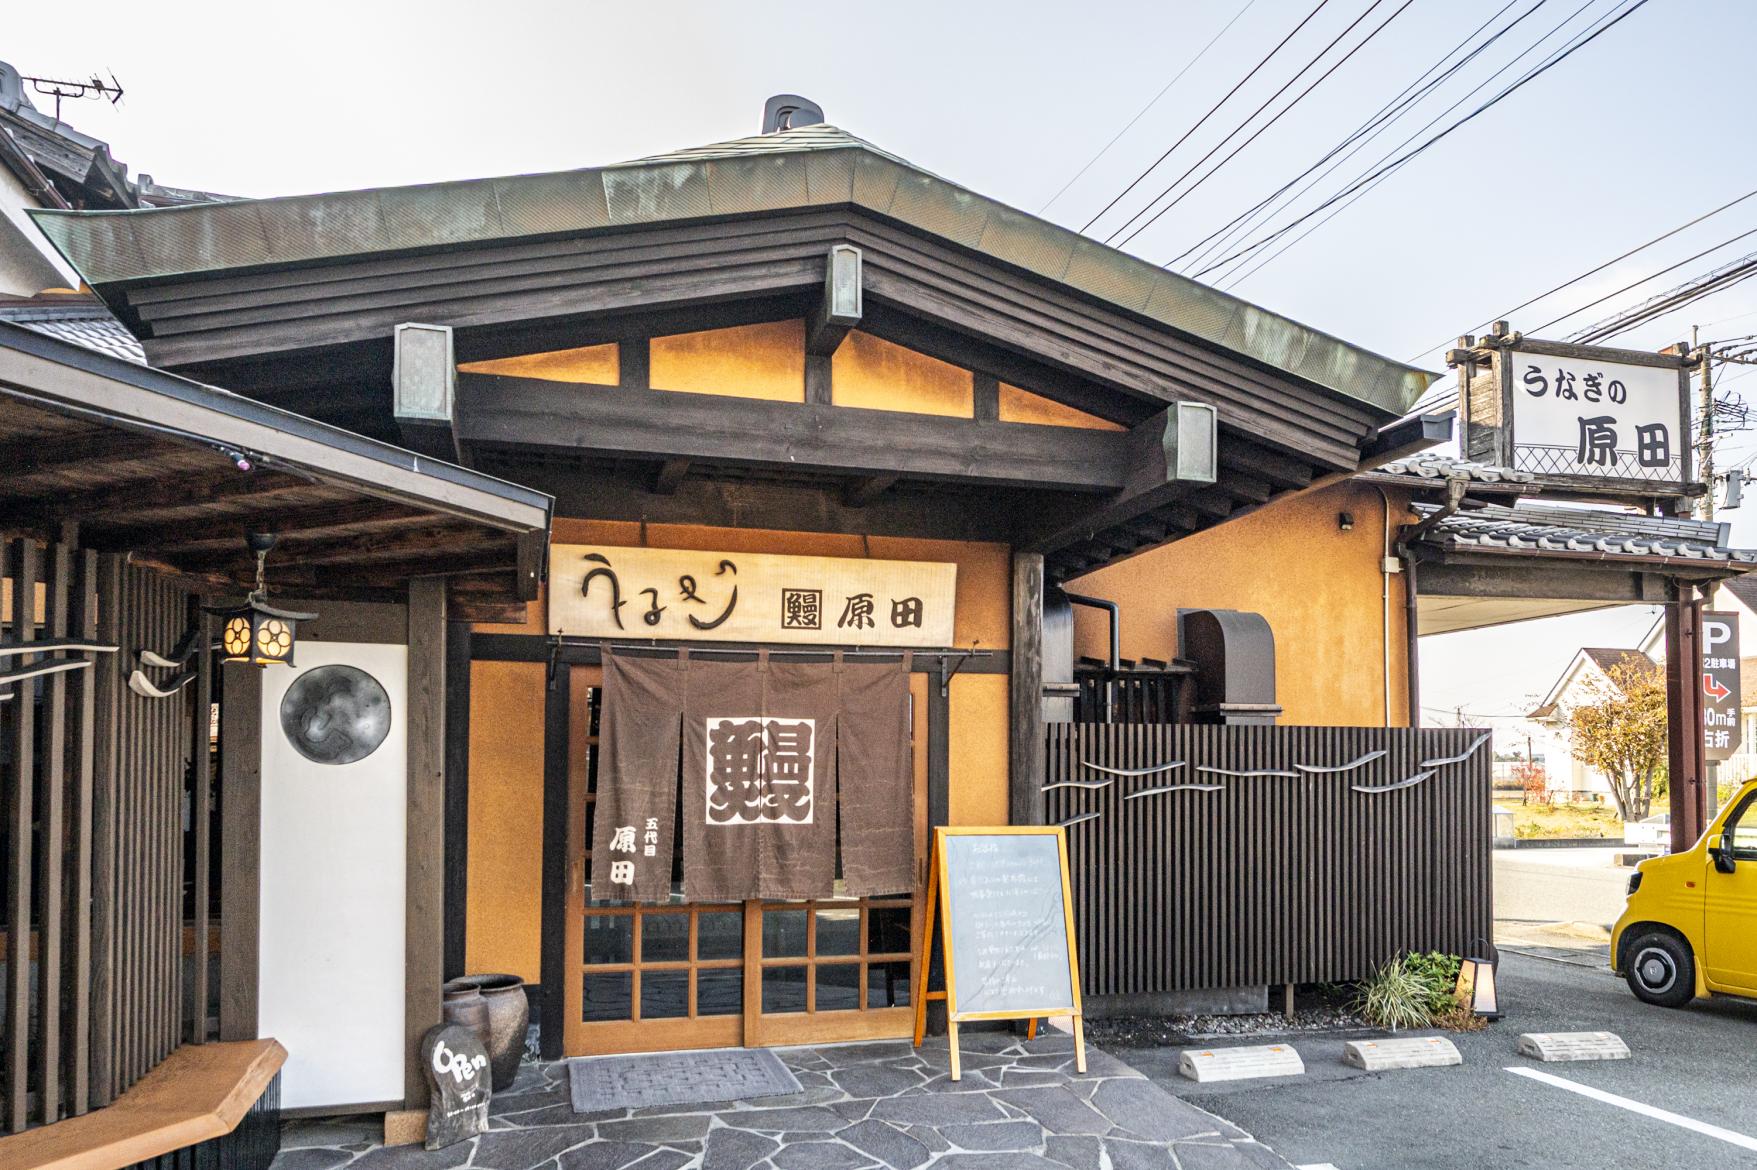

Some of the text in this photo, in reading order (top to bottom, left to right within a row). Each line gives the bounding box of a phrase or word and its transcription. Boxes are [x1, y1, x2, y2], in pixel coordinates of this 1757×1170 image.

[1523, 365, 1627, 405] うなぎの
[1576, 415, 1670, 468] 原田
[837, 592, 923, 629] 原田
[1702, 622, 1731, 654] P
[1703, 657, 1736, 669] 2駐車場
[609, 826, 637, 885] 原田
[644, 817, 659, 857] 五代目
